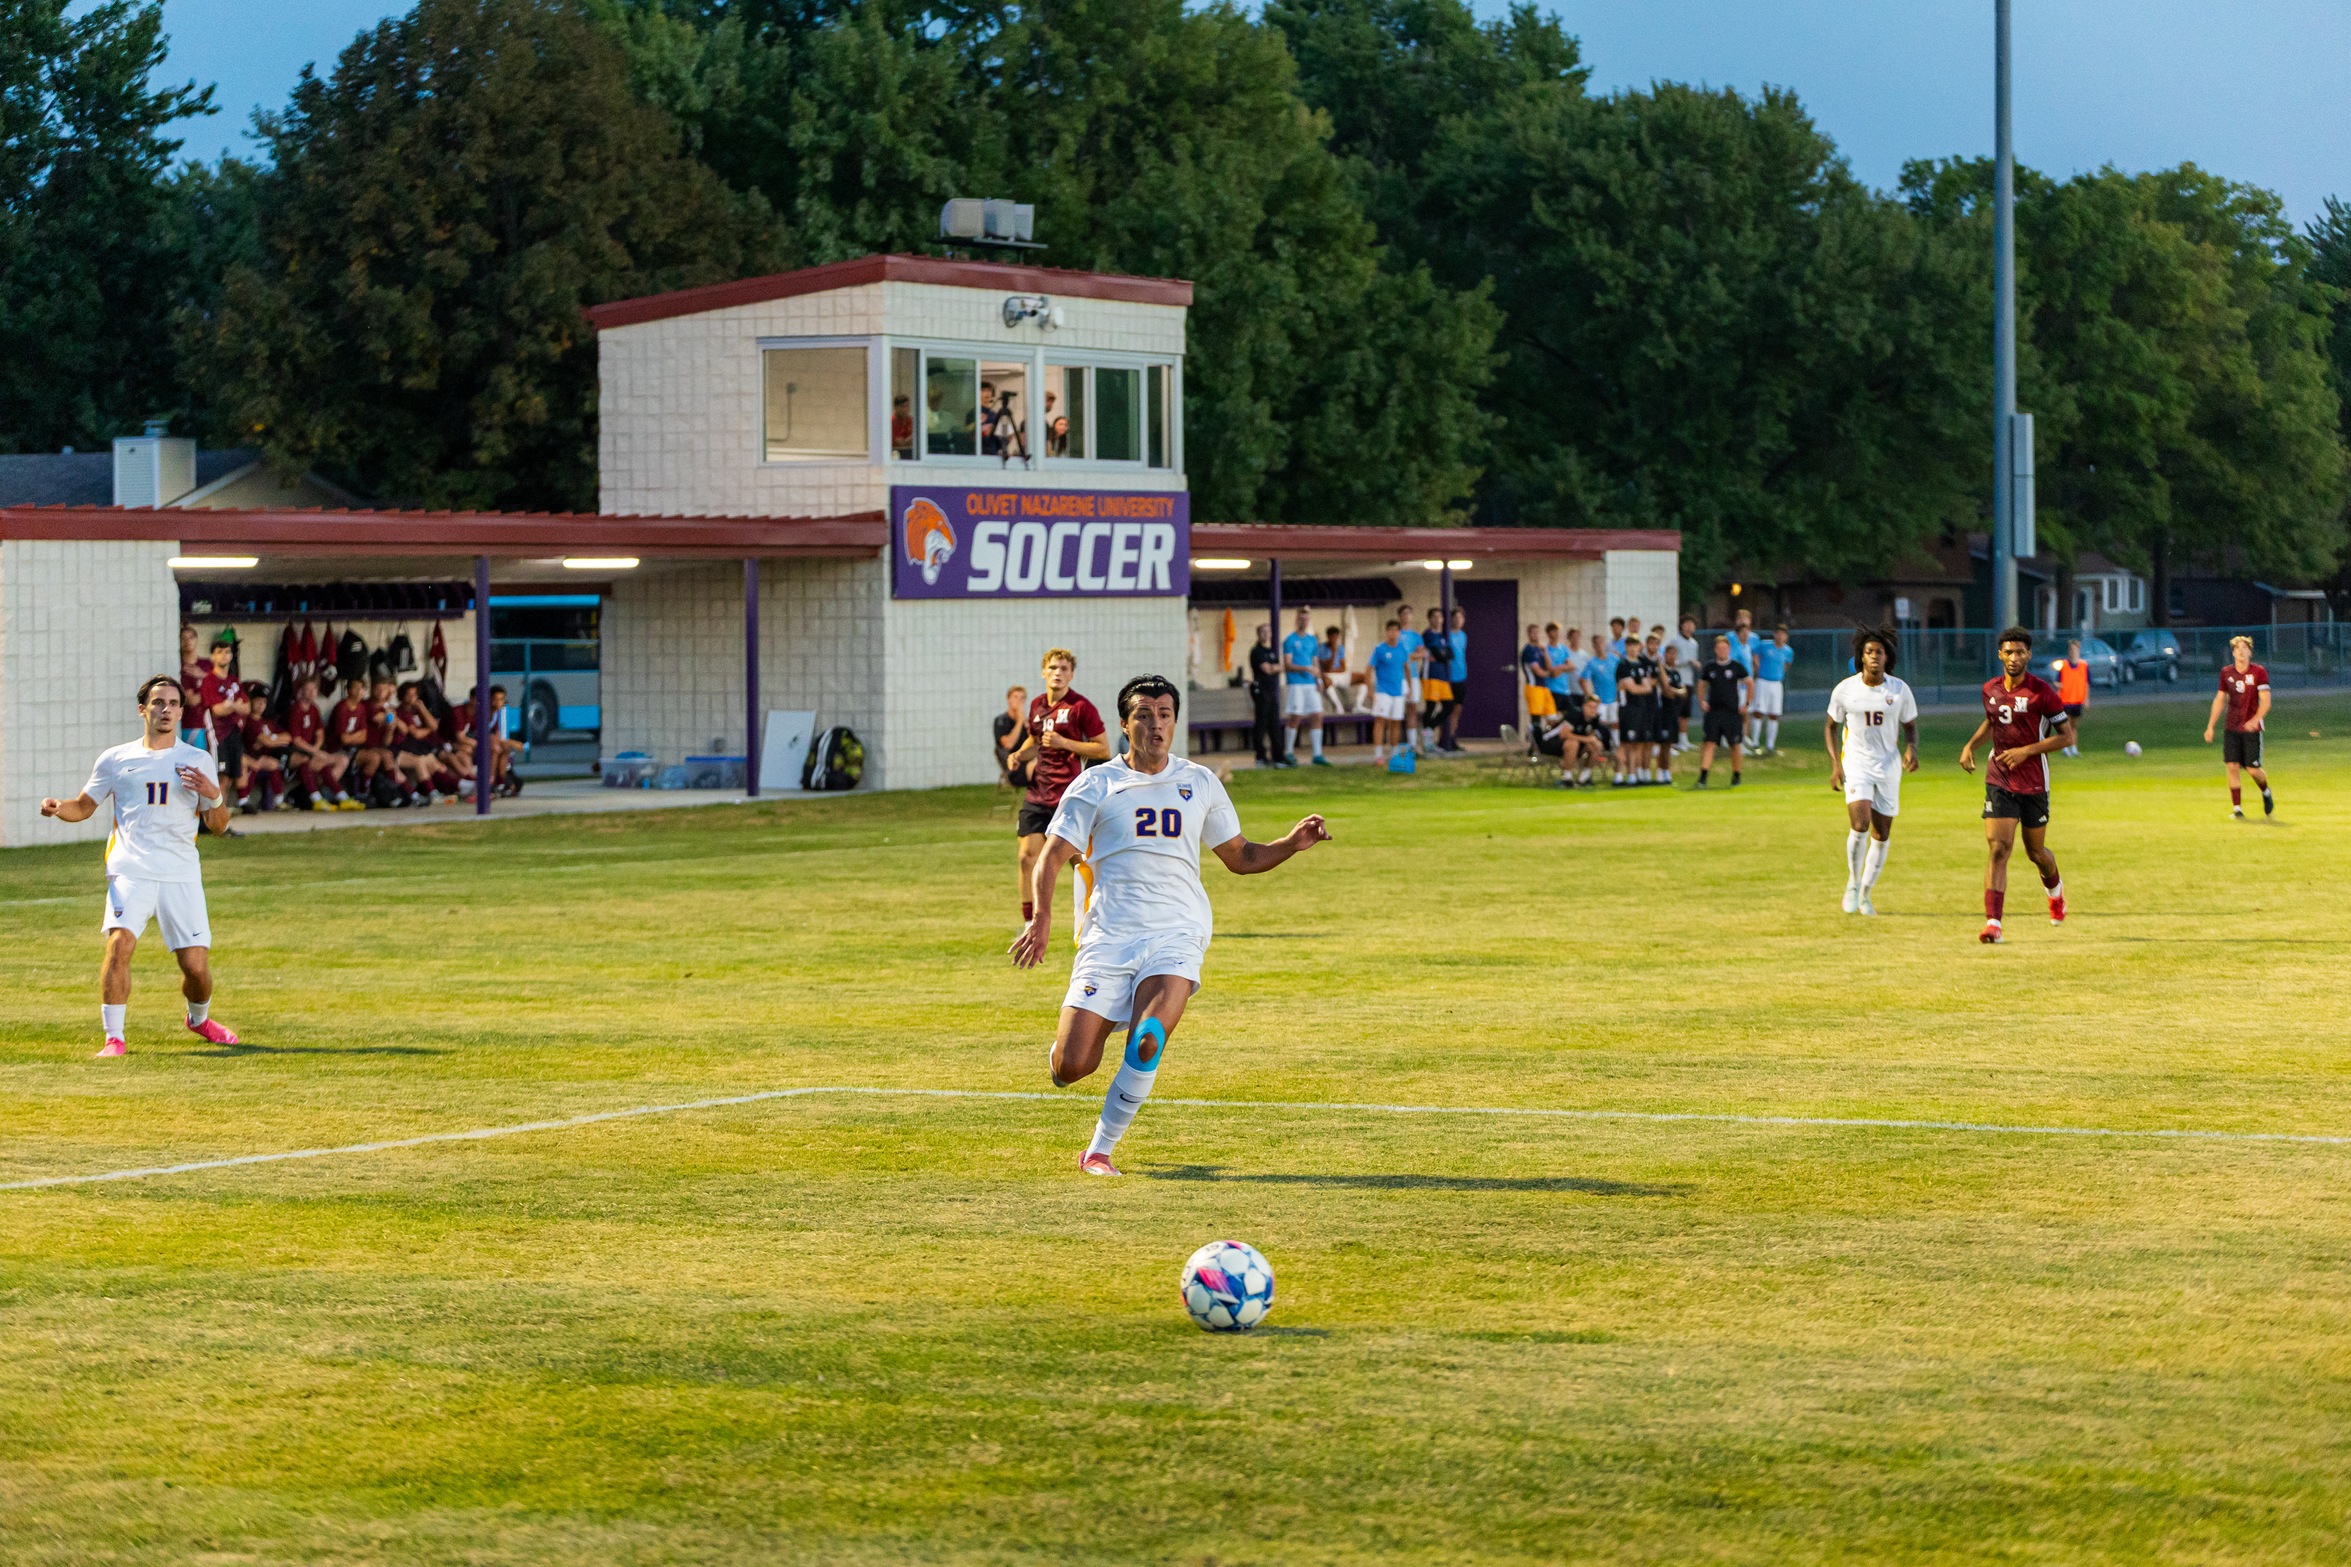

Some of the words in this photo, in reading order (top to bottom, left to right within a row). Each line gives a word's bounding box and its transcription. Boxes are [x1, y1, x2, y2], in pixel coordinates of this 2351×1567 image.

[966, 493, 1018, 516] OLIVET
[1021, 495, 1095, 517] NAZARENE
[1098, 496, 1174, 518] UNIVERSITY
[967, 521, 1176, 592] SOCCER
[1864, 711, 1884, 726] 16
[1998, 704, 2012, 724] 3
[146, 782, 168, 805] 11
[1135, 807, 1182, 838] 20
